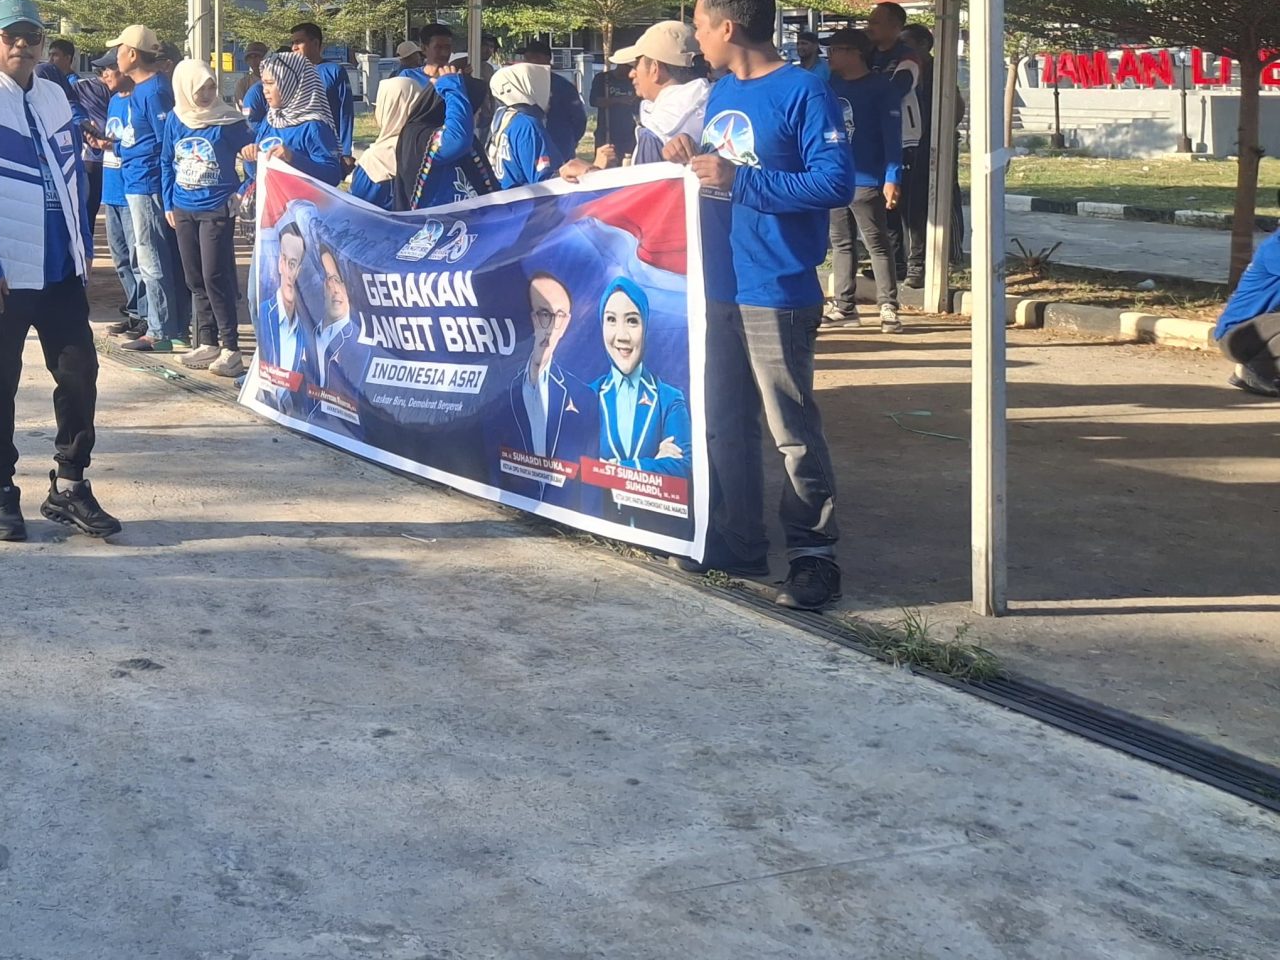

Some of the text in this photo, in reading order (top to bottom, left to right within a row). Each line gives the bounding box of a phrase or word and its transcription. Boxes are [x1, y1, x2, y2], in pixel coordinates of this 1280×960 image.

[361, 270, 479, 308] GERAKAN
[357, 311, 516, 356] LANGIT BIRU
[371, 362, 483, 388] INDONESIA ASRI
[372, 393, 393, 405] Laskar
[408, 397, 437, 409] Demokrat
[512, 451, 541, 467] SUHARDI
[604, 465, 616, 476] ST
[617, 468, 663, 487] SURAIDAH
[625, 480, 662, 498] SUHARDI,
